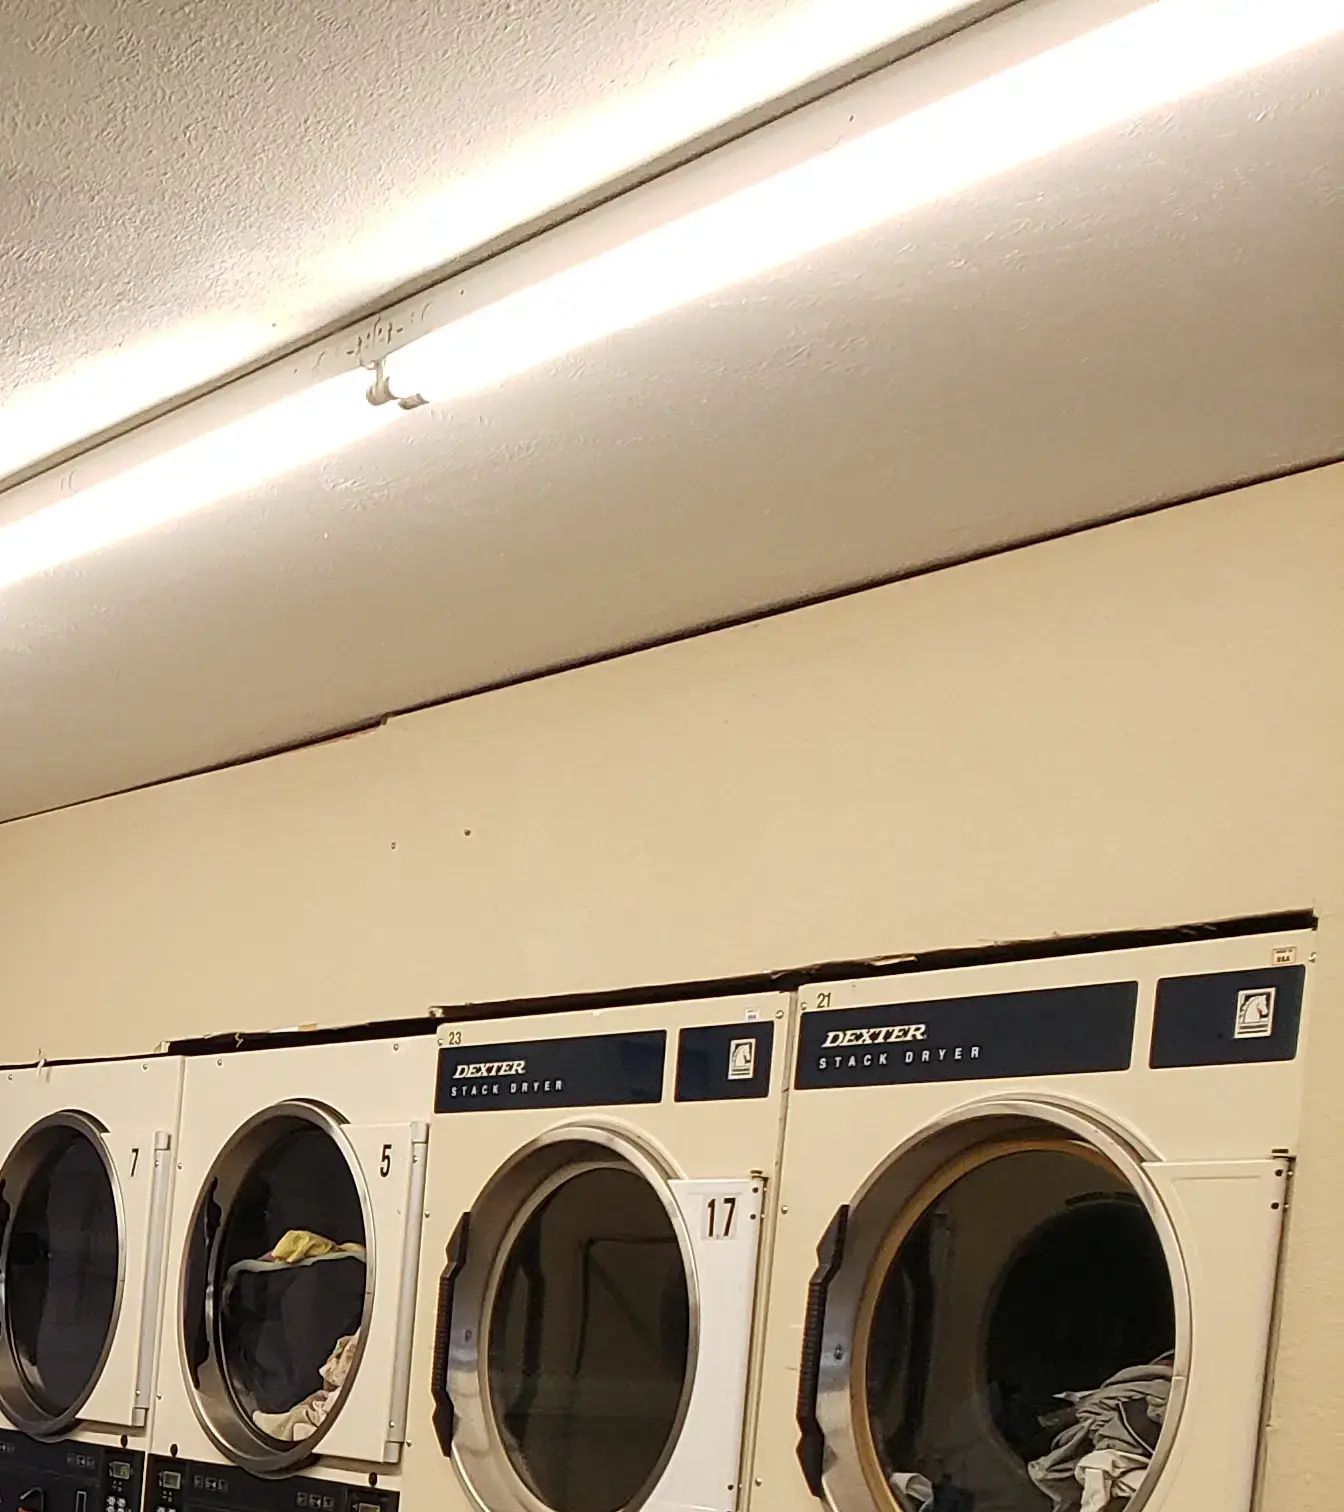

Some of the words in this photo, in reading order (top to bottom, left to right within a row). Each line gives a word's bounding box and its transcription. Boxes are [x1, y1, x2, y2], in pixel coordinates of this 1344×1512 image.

[816, 992, 832, 1009] 21
[448, 1031, 462, 1045] 23
[821, 1024, 927, 1048] DEXTER
[819, 1053, 888, 1069] STACK
[905, 1046, 980, 1063] DRYER
[452, 1060, 526, 1079] DEXTER
[450, 1083, 500, 1097] STACK
[510, 1080, 563, 1094] DRYER
[130, 1148, 140, 1177] 7
[379, 1144, 392, 1177] 5
[707, 1197, 736, 1238] 17
